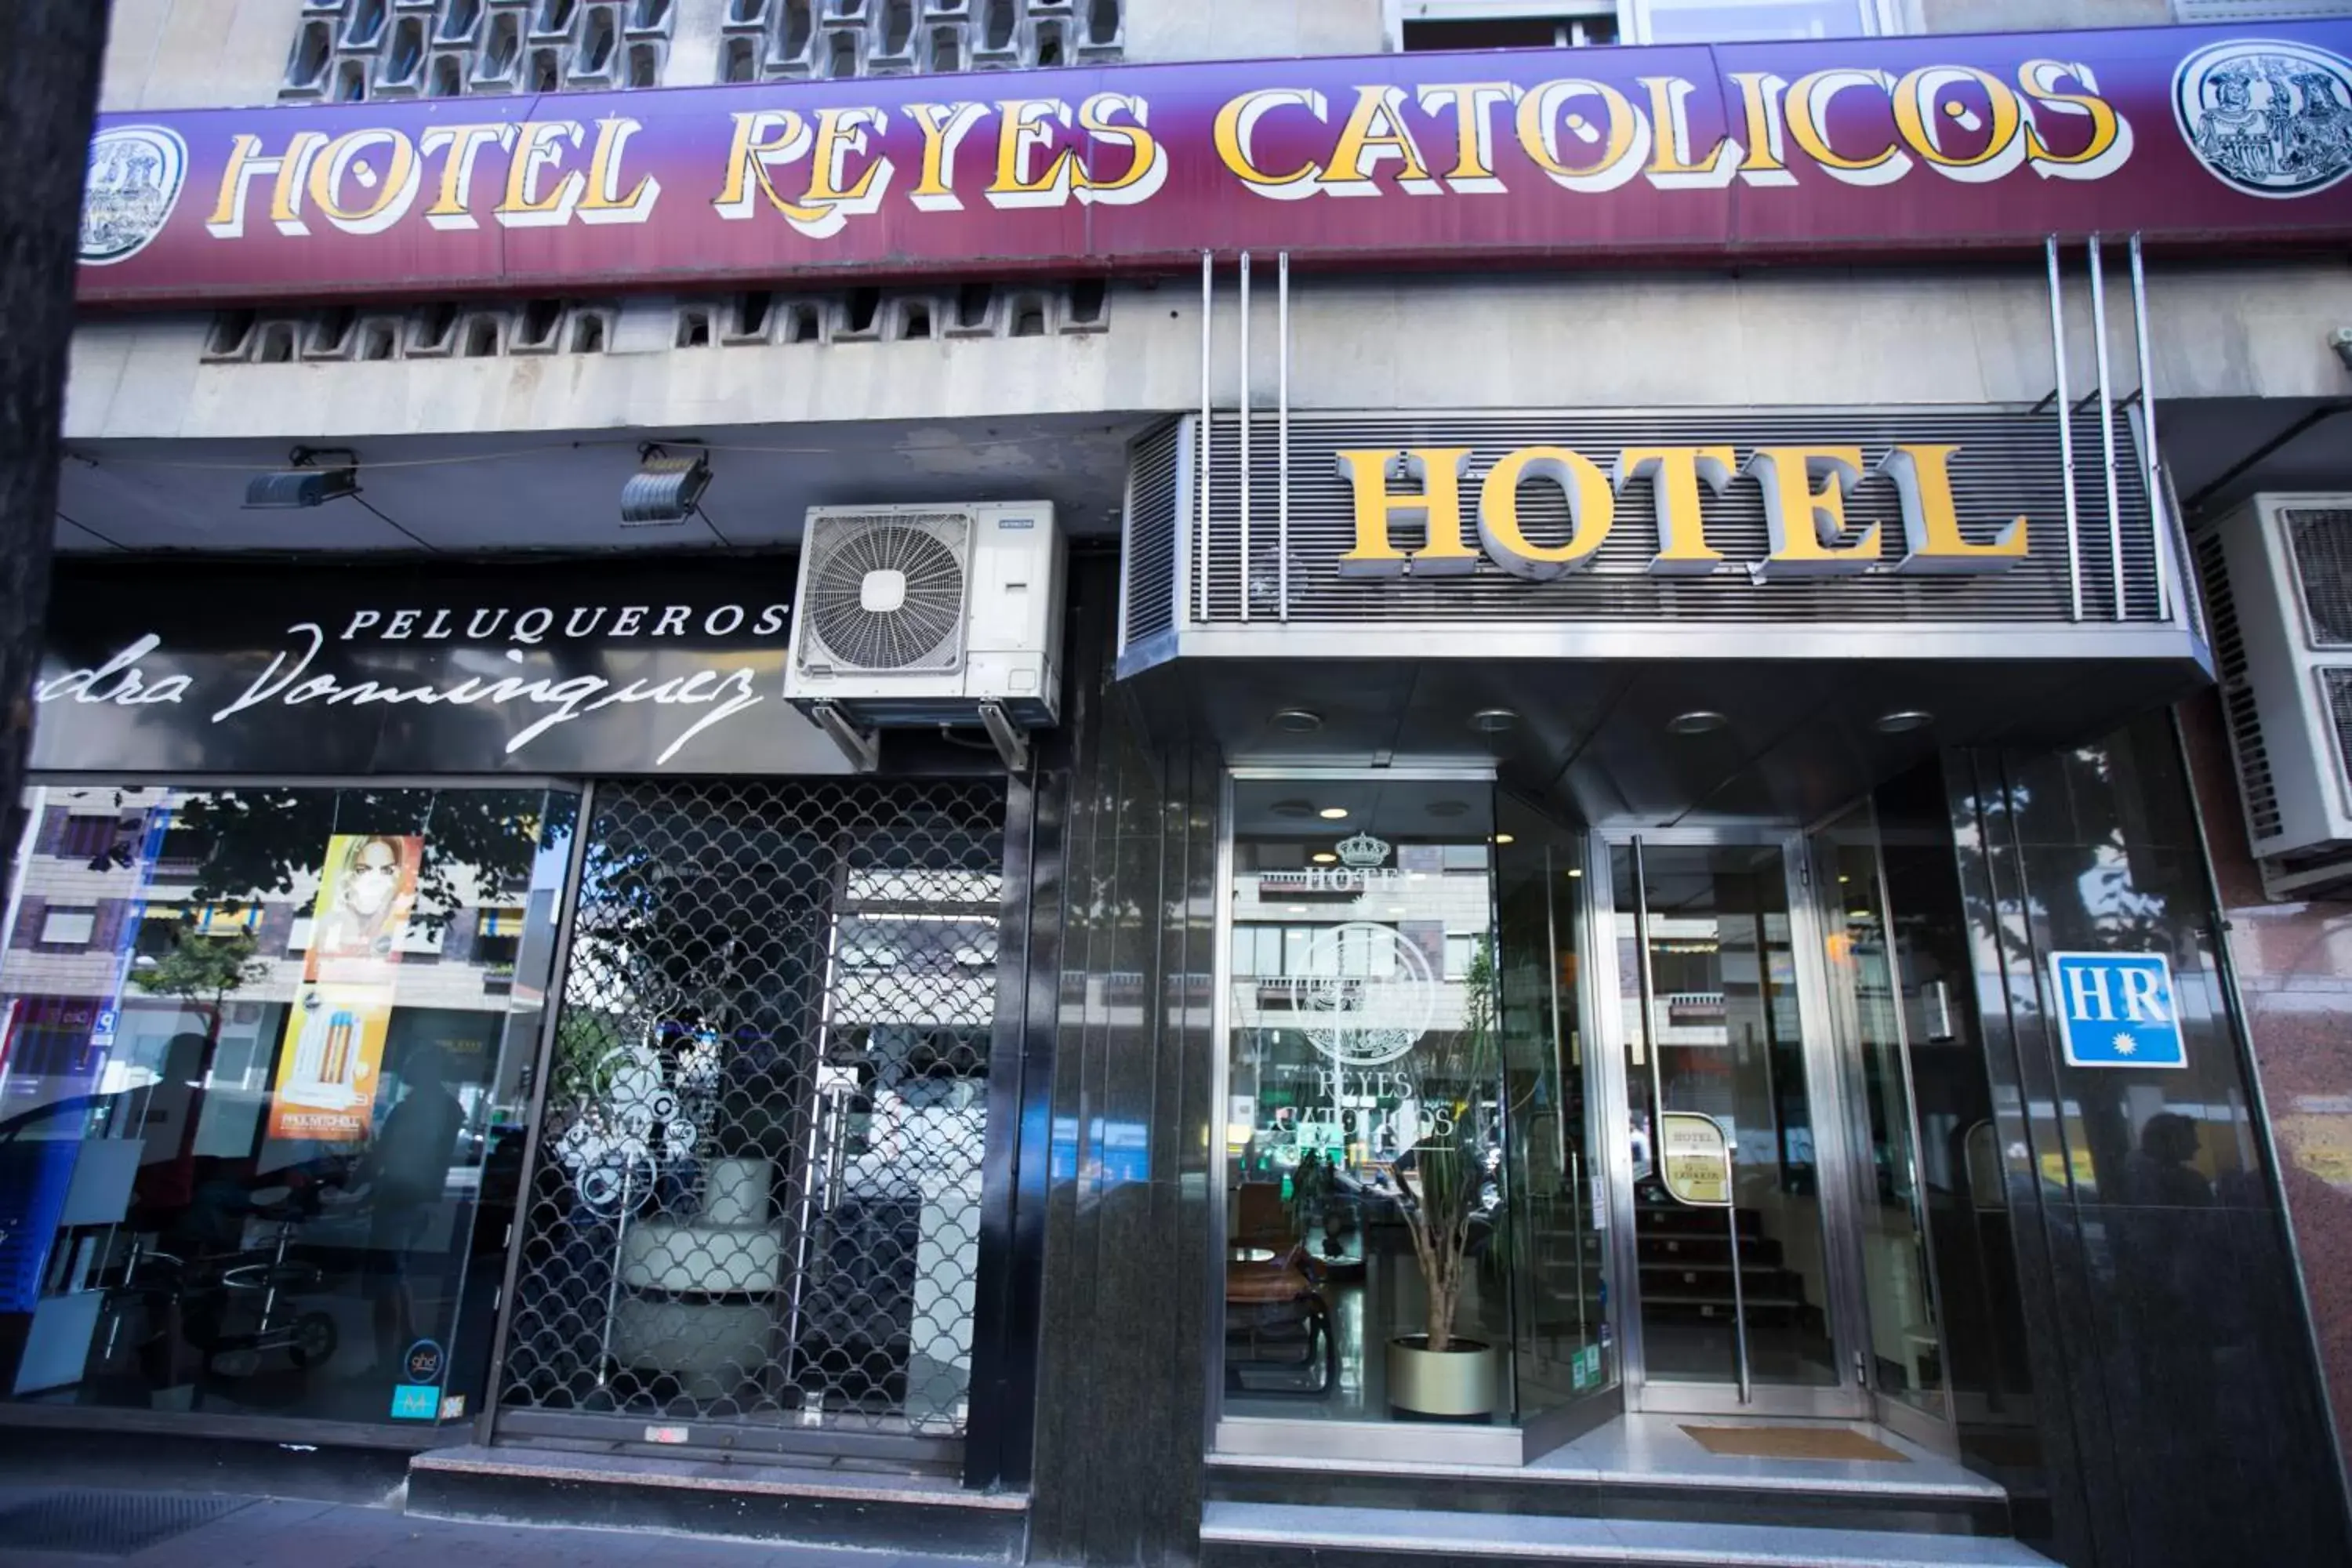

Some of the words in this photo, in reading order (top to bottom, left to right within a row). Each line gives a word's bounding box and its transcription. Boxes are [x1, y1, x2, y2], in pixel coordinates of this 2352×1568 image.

[205, 116, 661, 238] HOTEL
[710, 92, 1169, 238] REYES
[1213, 59, 2134, 201] CATOLICOS
[1335, 445, 2029, 579] HOTEL
[339, 604, 790, 644] PELUQUEROS
[34, 633, 194, 704] dra
[2063, 966, 2172, 1021] HR
[1318, 1071, 1413, 1099] REYES
[1276, 1106, 1454, 1137] CATOIOS
[1673, 1131, 1715, 1142] HOTEL
